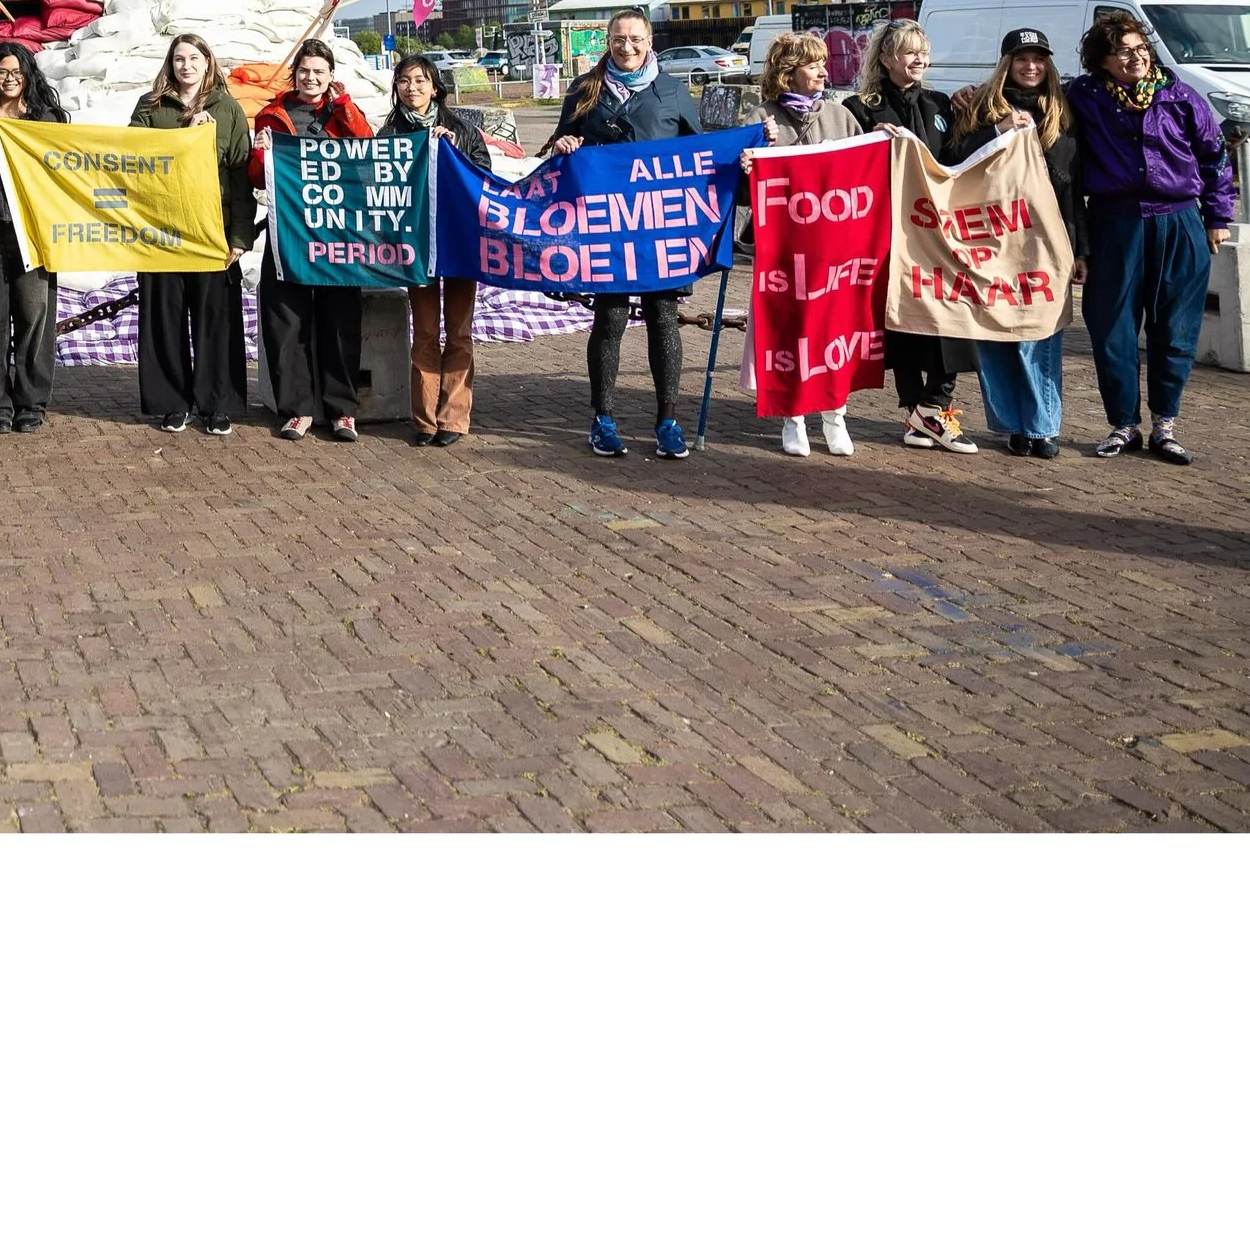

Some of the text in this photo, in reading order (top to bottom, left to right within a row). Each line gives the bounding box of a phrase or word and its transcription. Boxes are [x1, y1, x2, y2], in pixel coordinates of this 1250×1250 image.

[43, 150, 175, 175] CONSENT
[299, 138, 414, 160] POWER
[300, 160, 414, 183] ED BY
[629, 150, 716, 183] ALLE
[301, 183, 412, 208] CO MM
[481, 169, 562, 201] LAAT
[478, 184, 722, 236] BLOEMEN
[757, 177, 874, 228] FOOD
[52, 221, 183, 247] FREEDOM
[308, 241, 417, 266] PERIOD
[952, 246, 993, 270] OP
[758, 253, 879, 300] IS LIFE
[911, 265, 1055, 308] HAAR
[765, 330, 885, 383] IS LOVE
